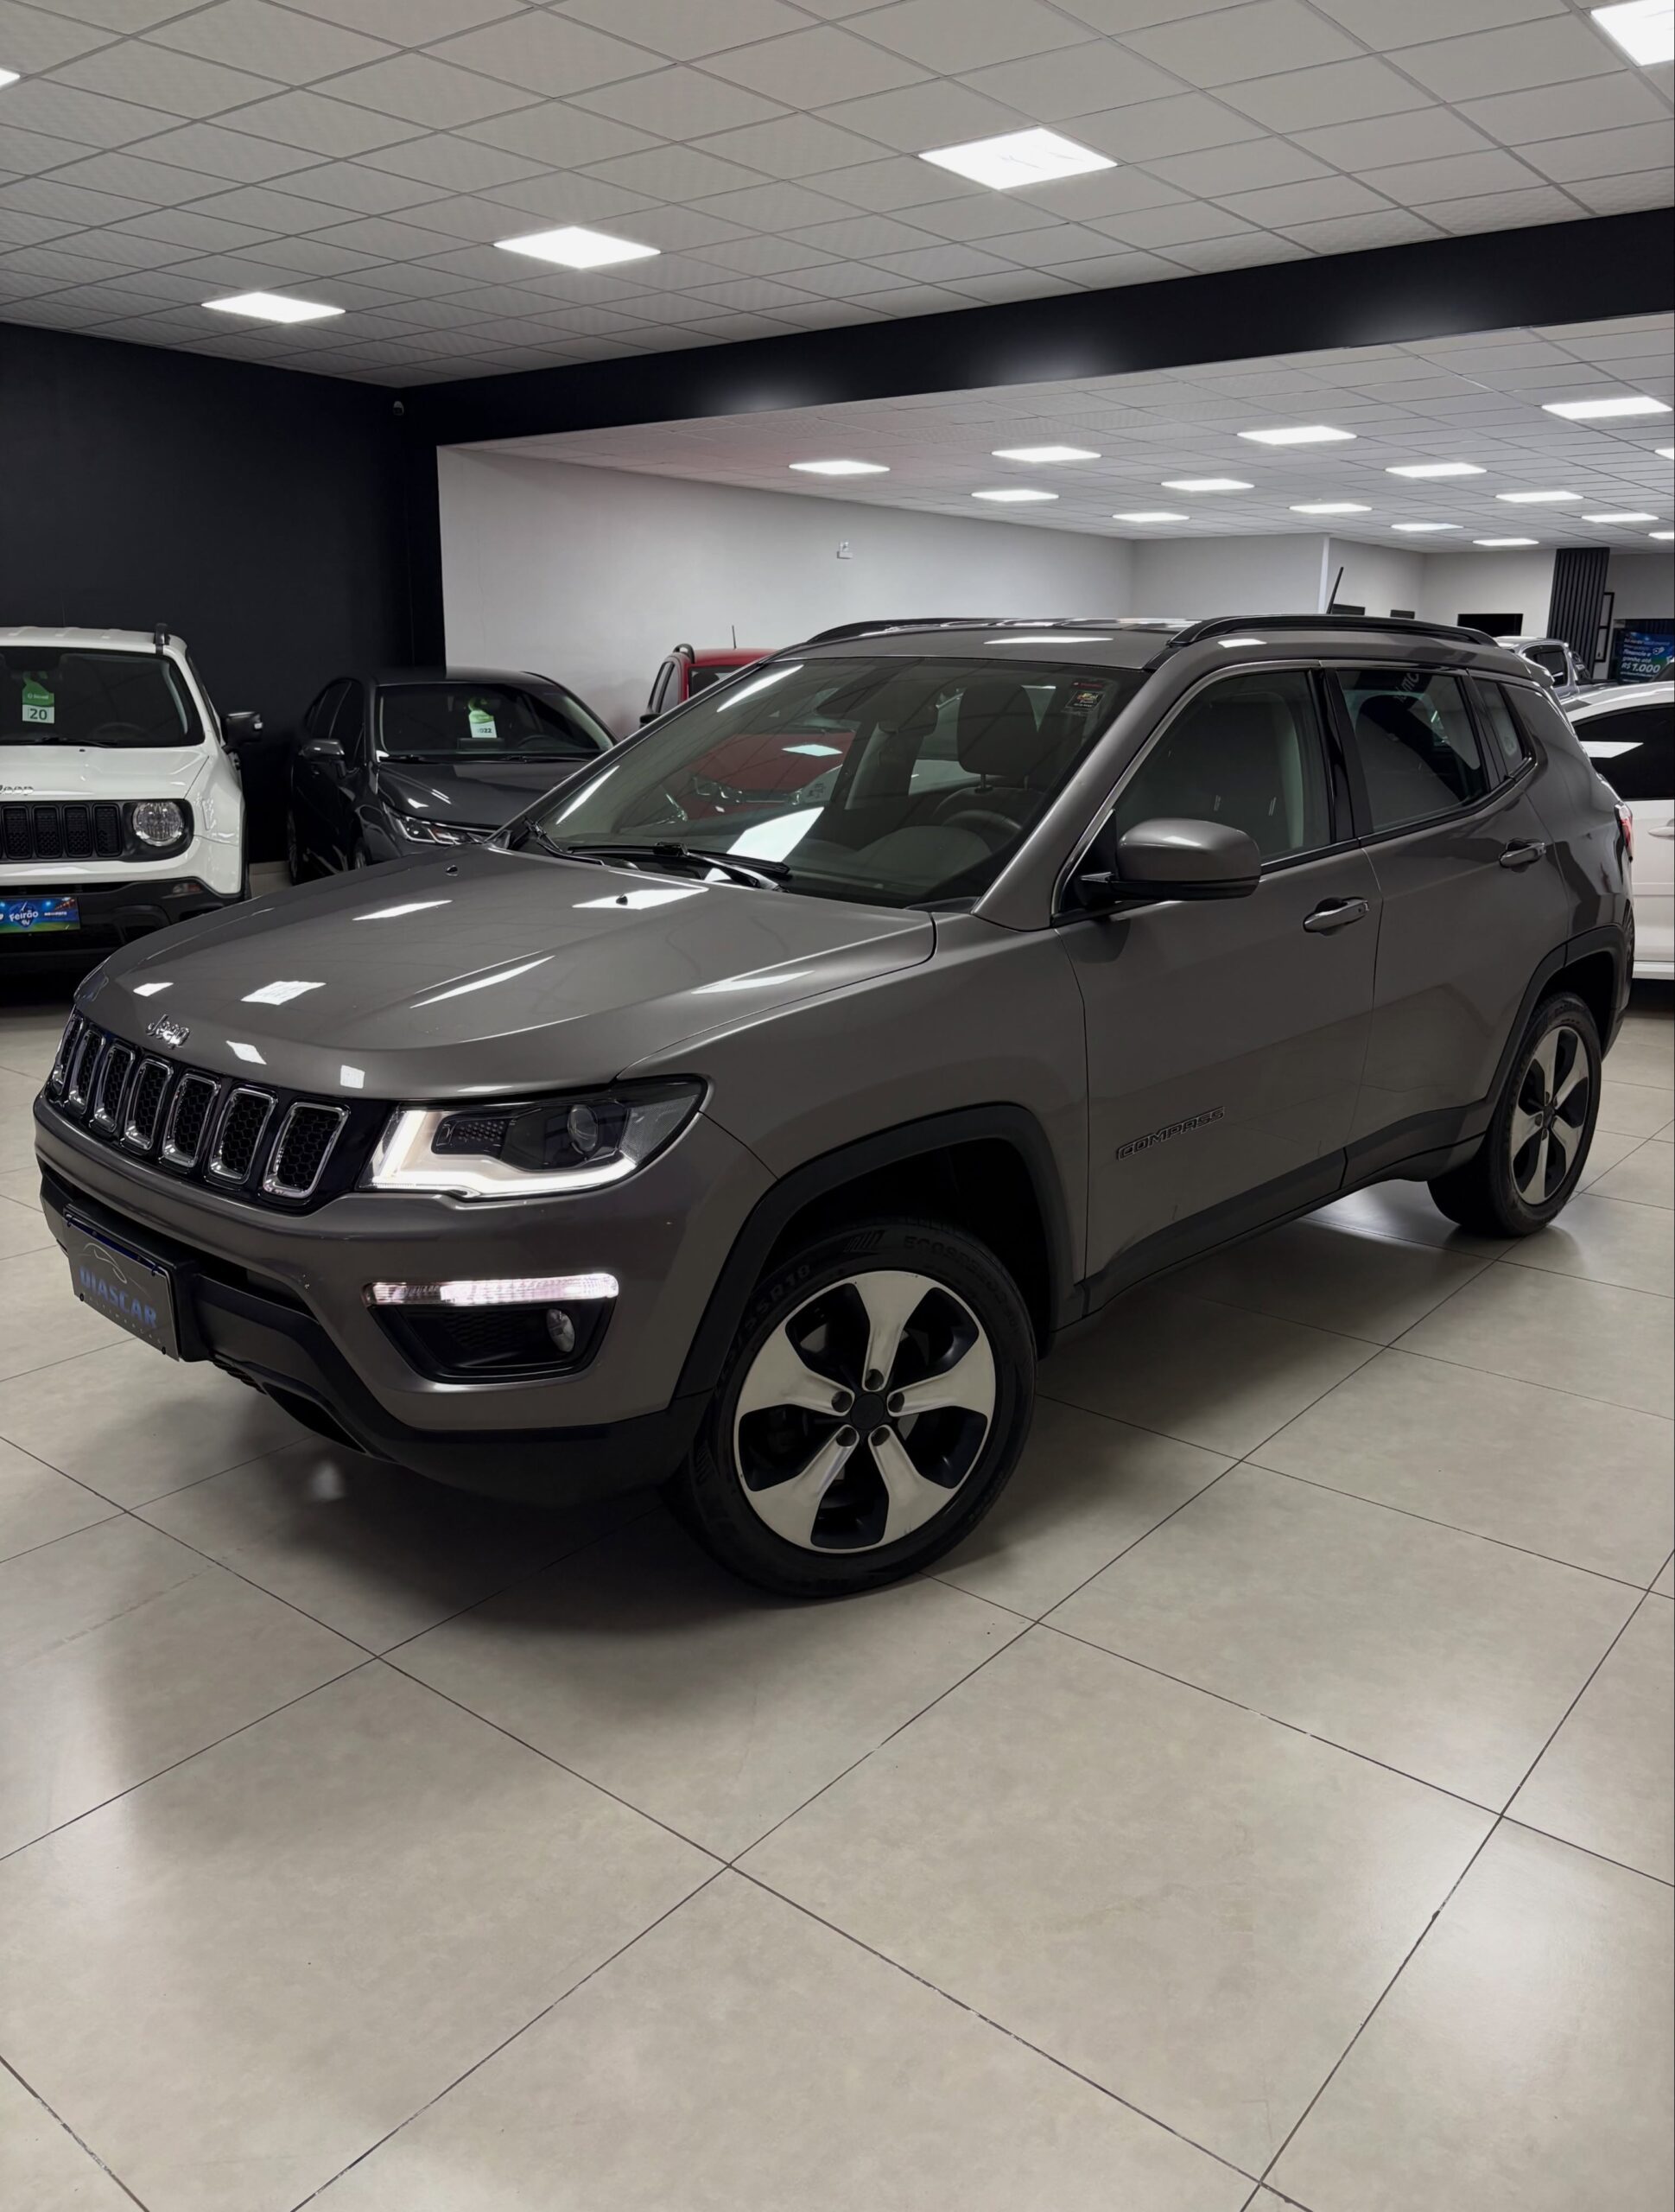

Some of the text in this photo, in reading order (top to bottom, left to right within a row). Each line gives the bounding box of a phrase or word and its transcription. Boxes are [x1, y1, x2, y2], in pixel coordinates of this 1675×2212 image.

[1632, 663, 1661, 673] 1.000
[29, 708, 48, 721] 20
[9, 910, 39, 922] Feirão
[147, 1014, 190, 1049] Jeep
[1116, 1106, 1225, 1161] COMPASS
